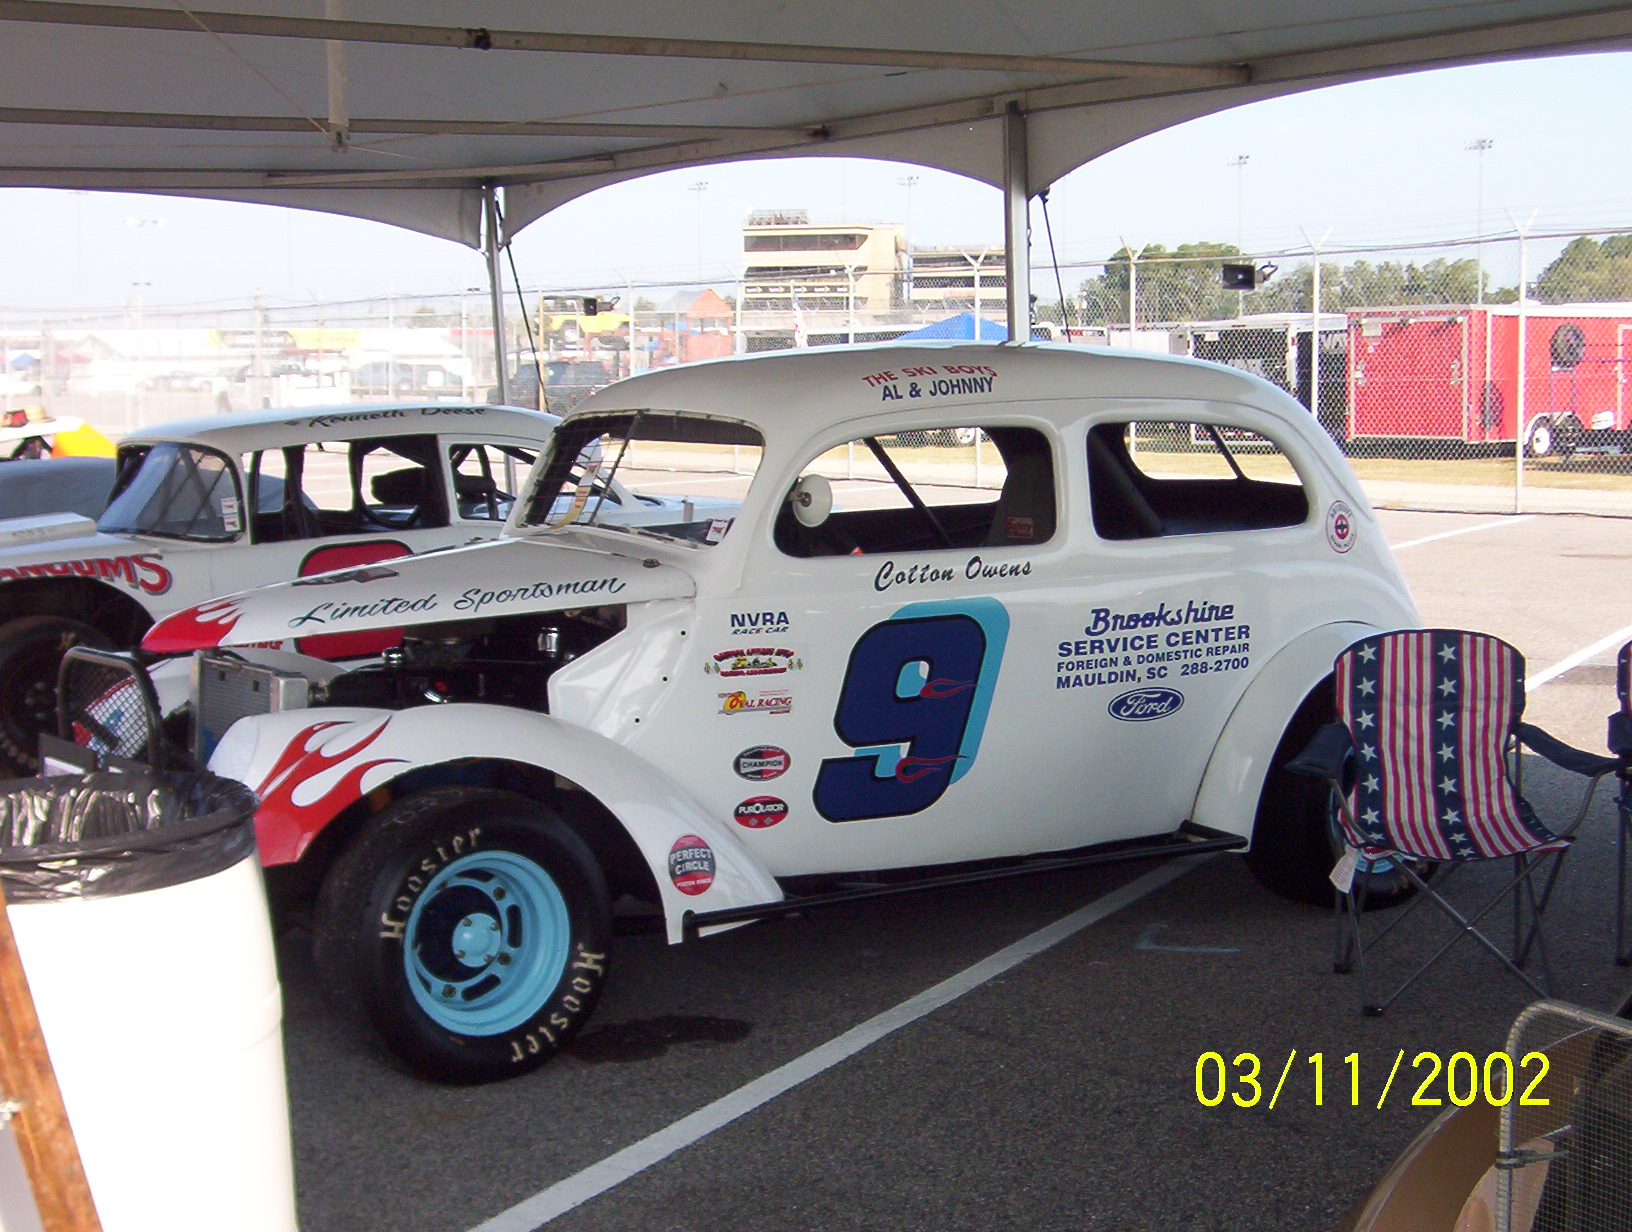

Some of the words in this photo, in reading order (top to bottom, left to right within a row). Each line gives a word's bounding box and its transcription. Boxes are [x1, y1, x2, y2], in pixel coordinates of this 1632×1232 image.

[862, 370, 898, 388] THE
[901, 365, 938, 378] SKI
[942, 365, 998, 378] BOYS
[881, 385, 904, 402] AL
[908, 381, 922, 399] &
[928, 376, 994, 398] JOHNNY
[873, 560, 955, 592] Cotton
[965, 555, 1033, 580] Owens
[288, 593, 438, 629] Limited
[453, 576, 627, 613] Sportsman
[730, 611, 790, 627] NVRA
[731, 627, 763, 635] RACE
[765, 626, 790, 634] CAR
[1084, 600, 1235, 637] Brookshire
[1057, 634, 1160, 658] SERVICE
[1165, 624, 1251, 648] CENTER
[1056, 656, 1119, 673] FOREIGN
[1122, 655, 1133, 667] &
[1136, 648, 1203, 665] DOMESTIC
[1205, 642, 1251, 658] REPAIR
[1056, 668, 1142, 690] MAULDIN,
[1146, 665, 1169, 681] SC
[1180, 656, 1250, 677] 288-2700
[756, 696, 793, 708] RACING
[812, 596, 1011, 823] 9
[1120, 691, 1174, 718] Ford
[741, 759, 783, 769] CHAMPION
[669, 847, 713, 865] PERFECT
[675, 860, 710, 875] CIRCLE
